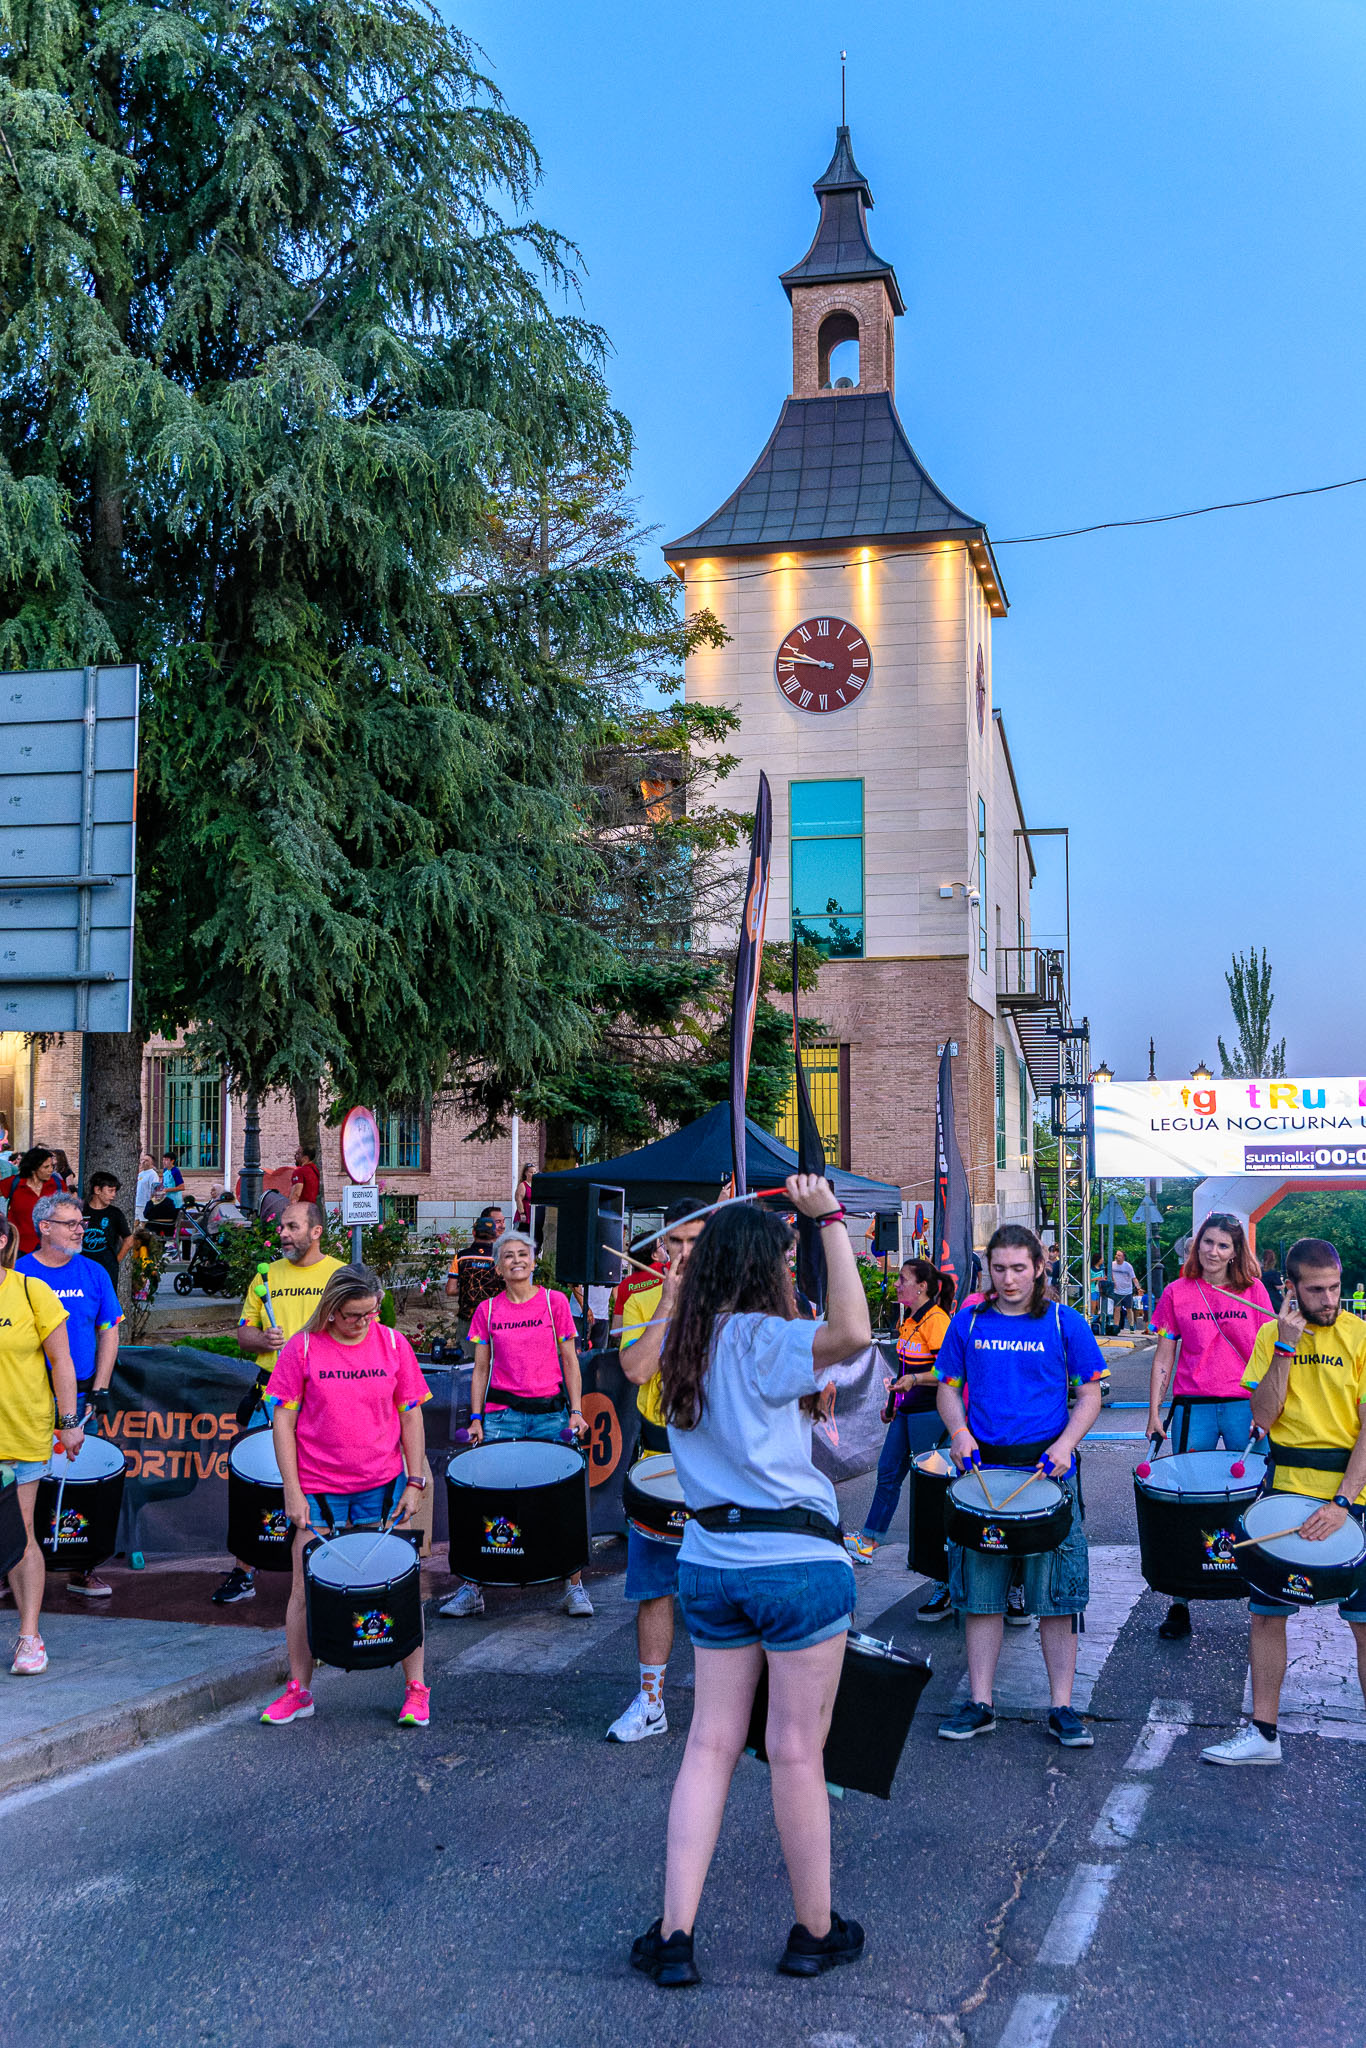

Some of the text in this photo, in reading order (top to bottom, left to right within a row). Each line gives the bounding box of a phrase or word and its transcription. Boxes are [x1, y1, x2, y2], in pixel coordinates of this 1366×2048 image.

[817, 620, 829, 636] XII
[798, 688, 814, 708] VII
[835, 688, 847, 703] V
[818, 694, 828, 710] VI
[1150, 1117, 1219, 1131] LEGUA
[1227, 1116, 1352, 1130] NOCTURNA
[1245, 1151, 1315, 1163] sumialki
[352, 1190, 373, 1198] RESERVADO
[348, 1211, 377, 1219] AYUNTAMIENTO
[271, 1287, 323, 1298] BATUKAIK
[1191, 1310, 1247, 1320] BATUKAIKA
[491, 1319, 543, 1331] BATUKAIKA
[974, 1339, 1045, 1352] BATUKAIKA
[1293, 1353, 1344, 1367] TUKAIKA
[319, 1369, 387, 1379] BATUKAIKA
[98, 1410, 240, 1440] VENTOS
[481, 1546, 525, 1555] BATUKAIKA
[1282, 1587, 1314, 1599] BATUKAIKA
[353, 1636, 394, 1646] BATUKAIKA
